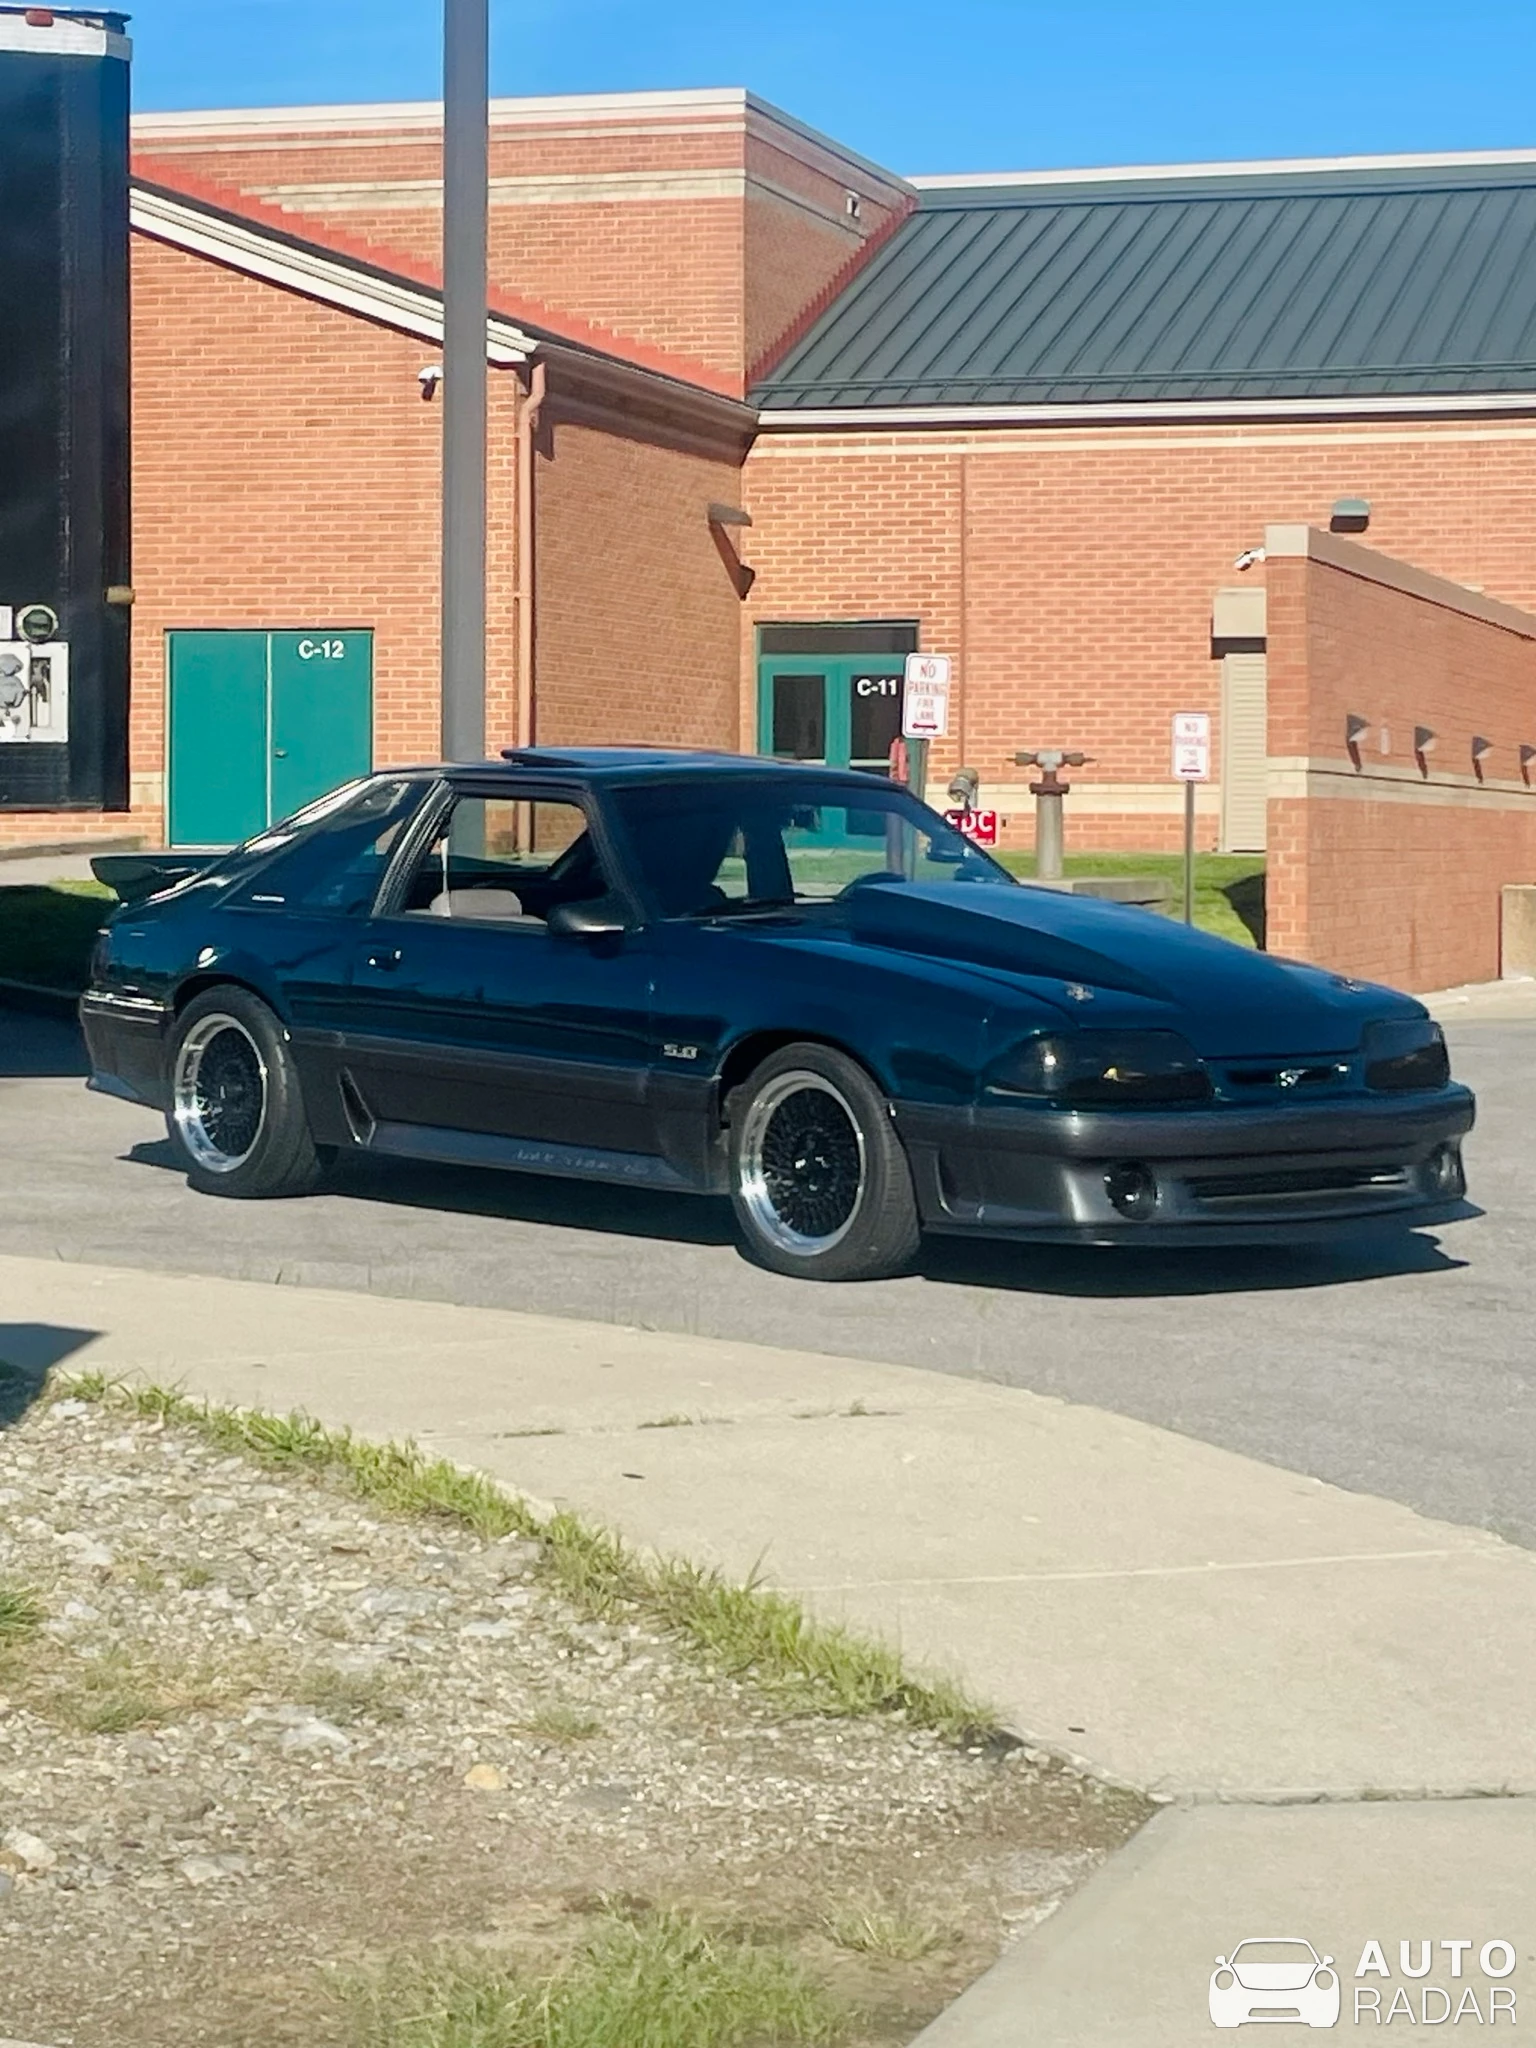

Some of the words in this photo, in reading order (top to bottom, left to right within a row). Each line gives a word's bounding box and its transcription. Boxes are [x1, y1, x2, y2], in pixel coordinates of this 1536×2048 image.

[298, 640, 345, 659] C-12
[920, 663, 936, 678] NO
[857, 678, 898, 696] C-11
[664, 1043, 698, 1060] 5.0
